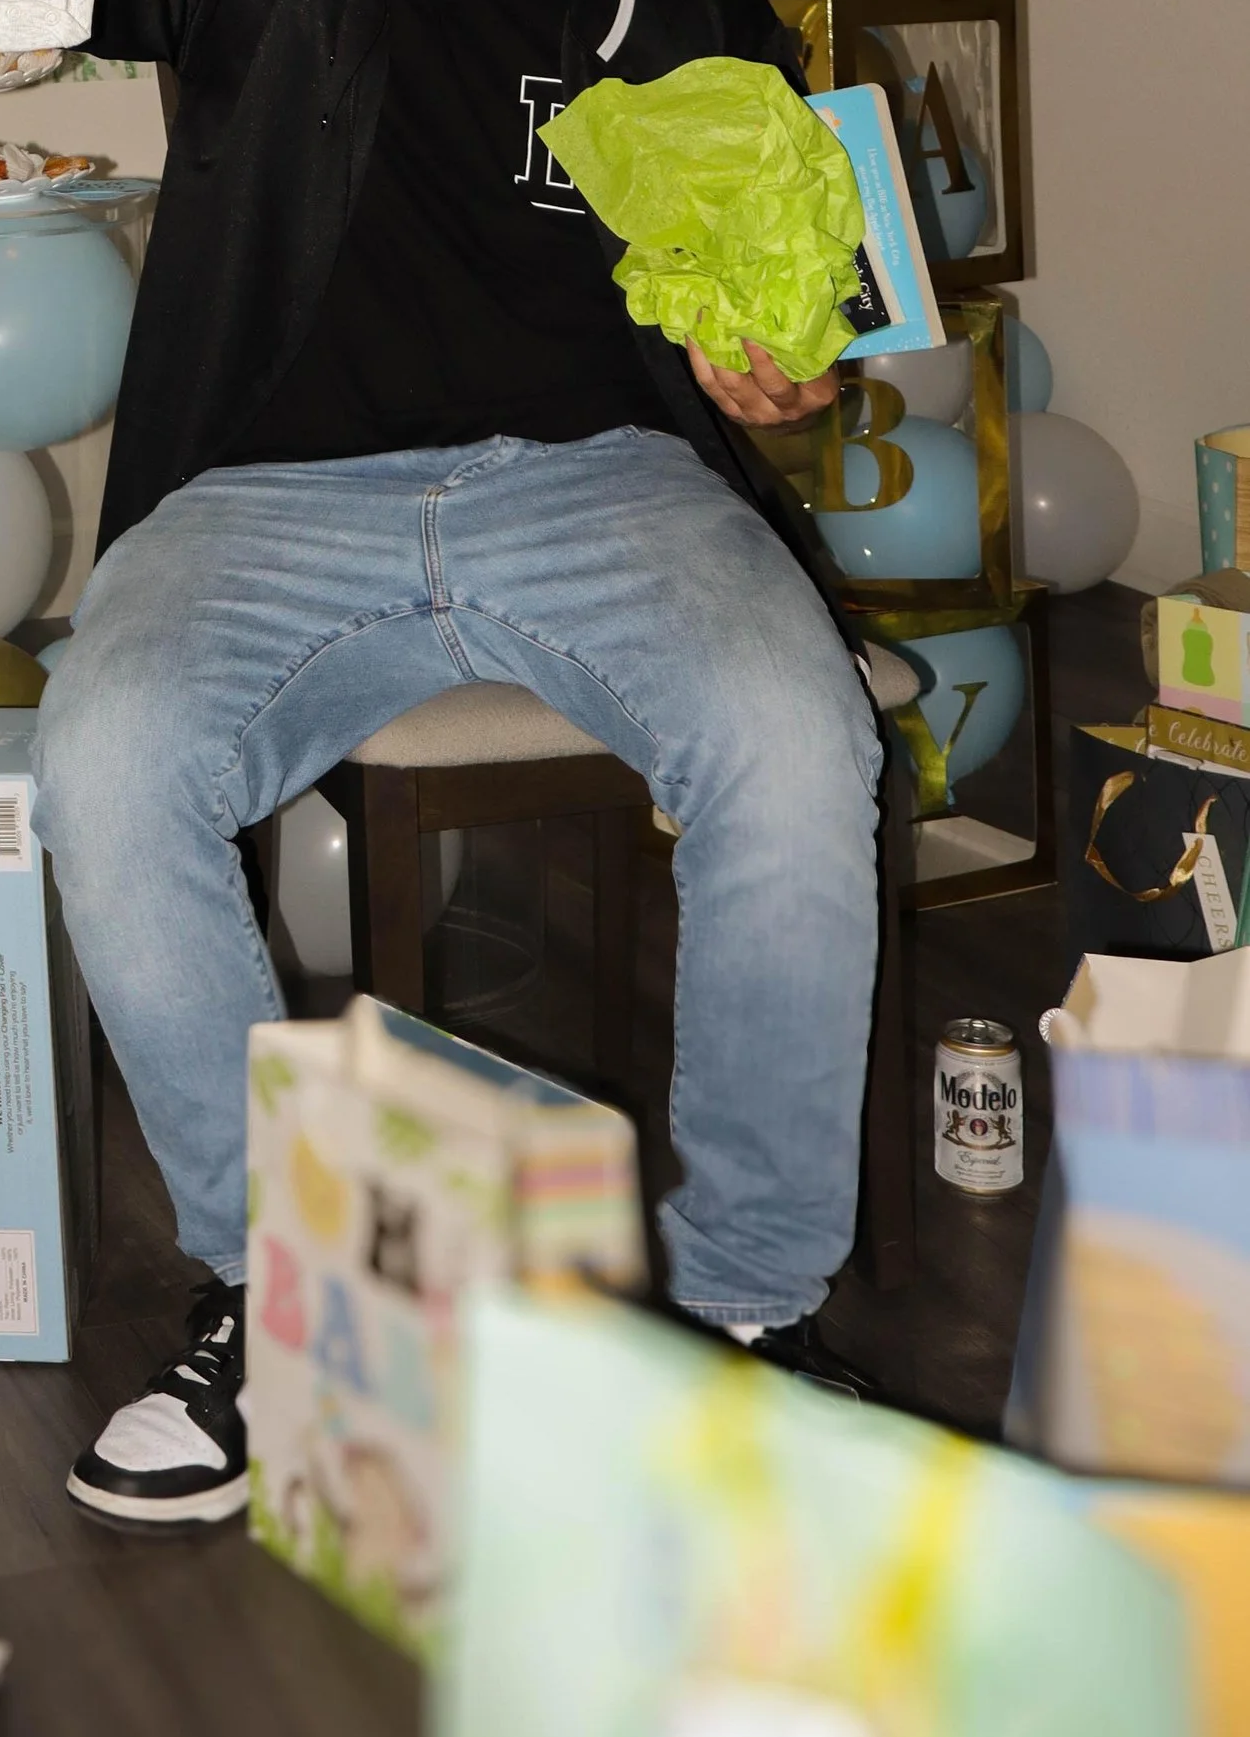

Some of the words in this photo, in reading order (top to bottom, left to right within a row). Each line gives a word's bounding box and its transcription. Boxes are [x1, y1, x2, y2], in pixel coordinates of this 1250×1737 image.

[905, 60, 976, 195] A
[804, 376, 914, 512] B
[892, 681, 990, 824] Y
[1168, 721, 1249, 762] Celebrate
[1197, 856, 1233, 948] CHEERS
[0, 998, 8, 1033] Changing
[940, 1070, 1017, 1112] Modelo
